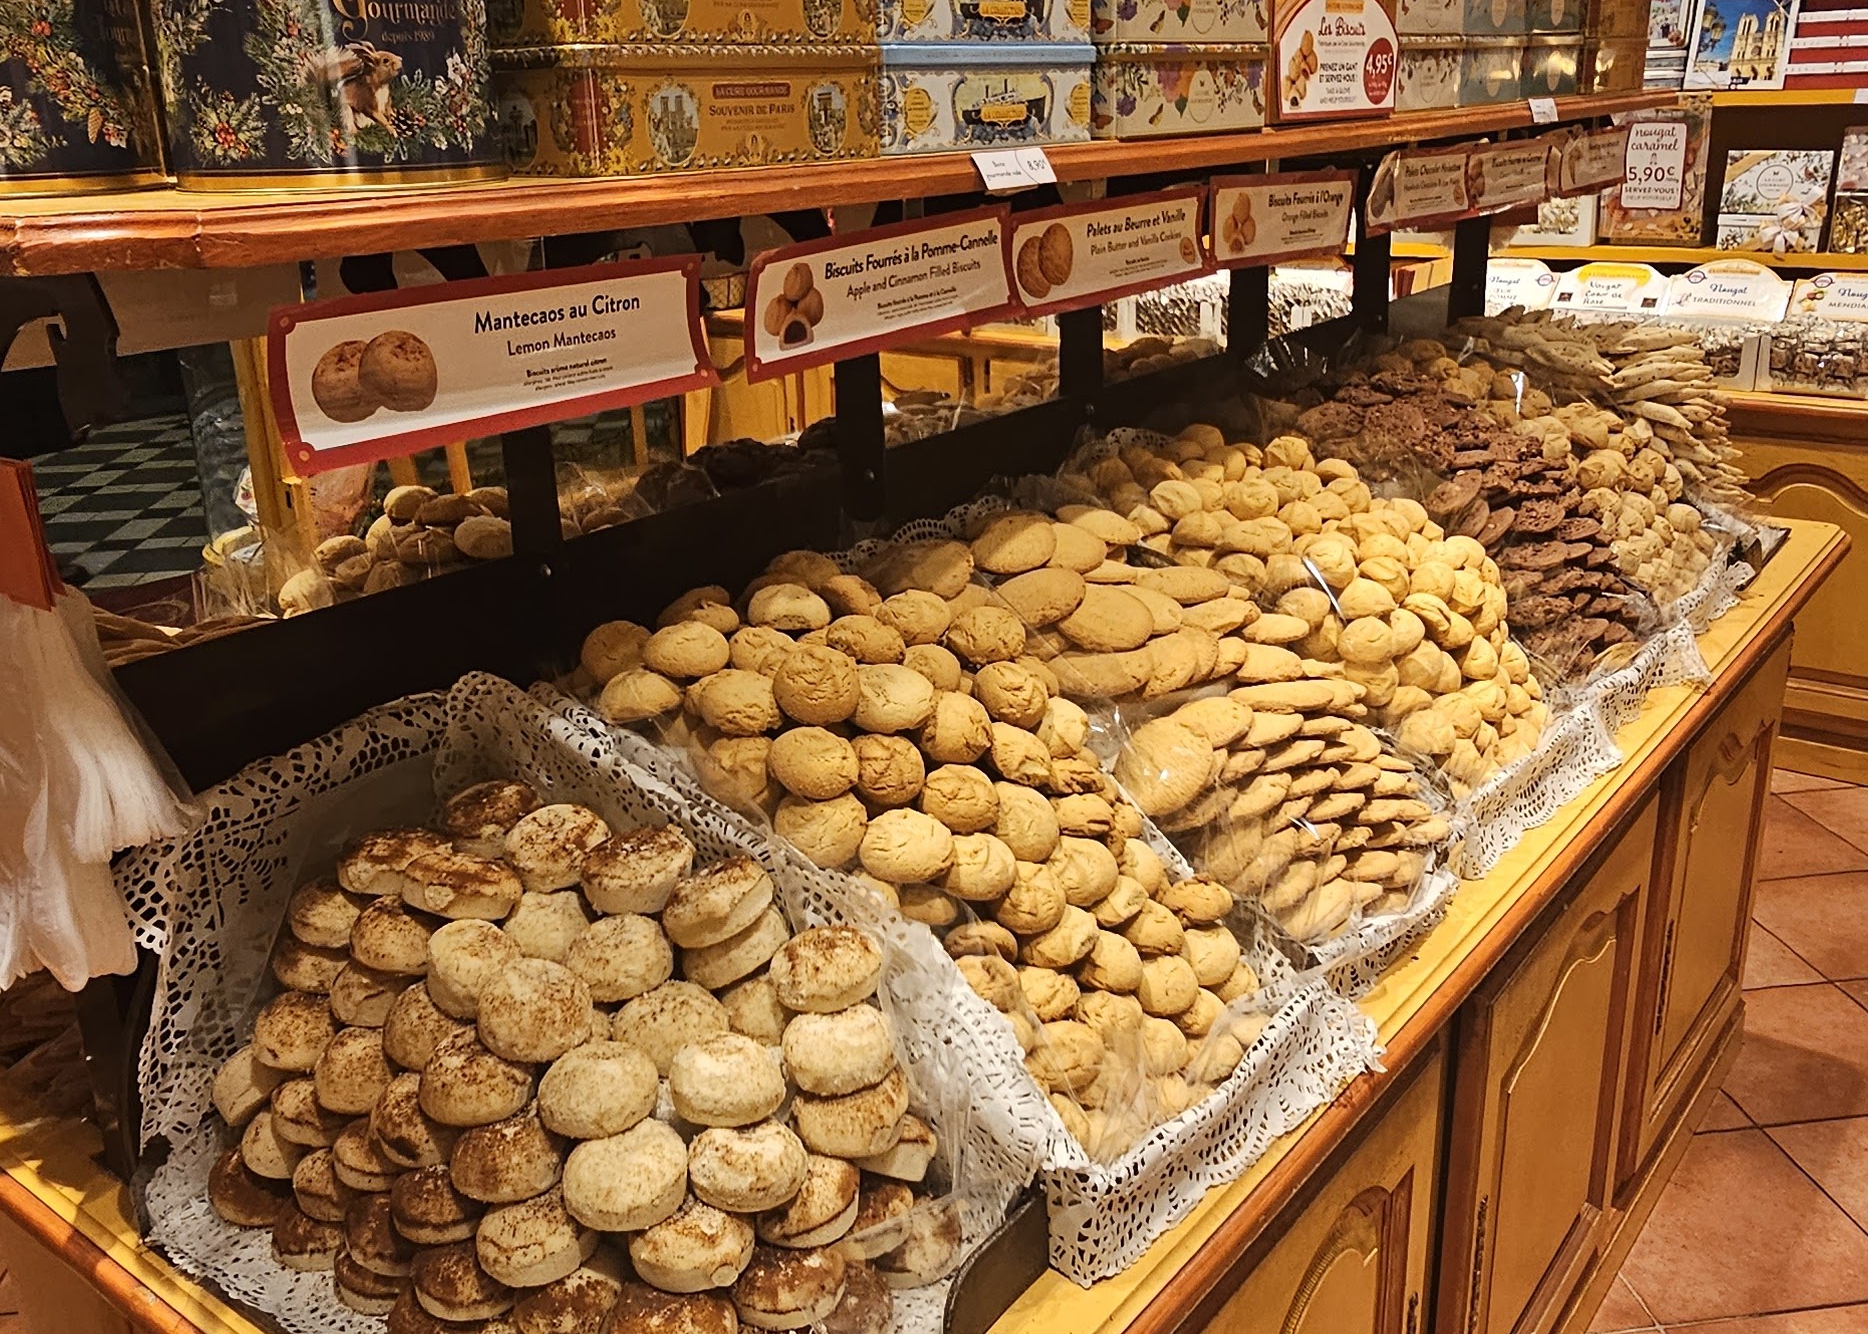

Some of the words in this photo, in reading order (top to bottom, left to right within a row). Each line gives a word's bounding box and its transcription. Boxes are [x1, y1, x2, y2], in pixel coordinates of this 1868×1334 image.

[709, 105, 755, 117] SOUVENIR
[769, 103, 795, 115] PARIS
[1631, 138, 1679, 151] caramel
[1635, 127, 1676, 142] nougat
[1087, 221, 1111, 238] Palets
[1113, 224, 1123, 234] au
[1124, 216, 1151, 232] Beurre
[1152, 215, 1161, 226] et
[1161, 208, 1186, 224] Vanille
[824, 258, 864, 280] Biscuits
[865, 251, 903, 273] Fourrés
[903, 247, 910, 264] à
[911, 245, 920, 262] la
[921, 229, 998, 261] Pomme-Cannelle
[846, 281, 872, 301] Apple
[872, 276, 887, 292] and
[888, 271, 928, 289] Cinnamon
[929, 264, 951, 280] Filled
[952, 258, 982, 275] Biscuits
[1709, 282, 1748, 296] Nougat
[1693, 296, 1757, 307] TRADITIONNEL
[473, 307, 565, 335] Mantecaos
[569, 303, 588, 321] au
[591, 292, 641, 317] Citron
[506, 337, 550, 357] Lemon
[553, 326, 617, 352] Mantecaos
